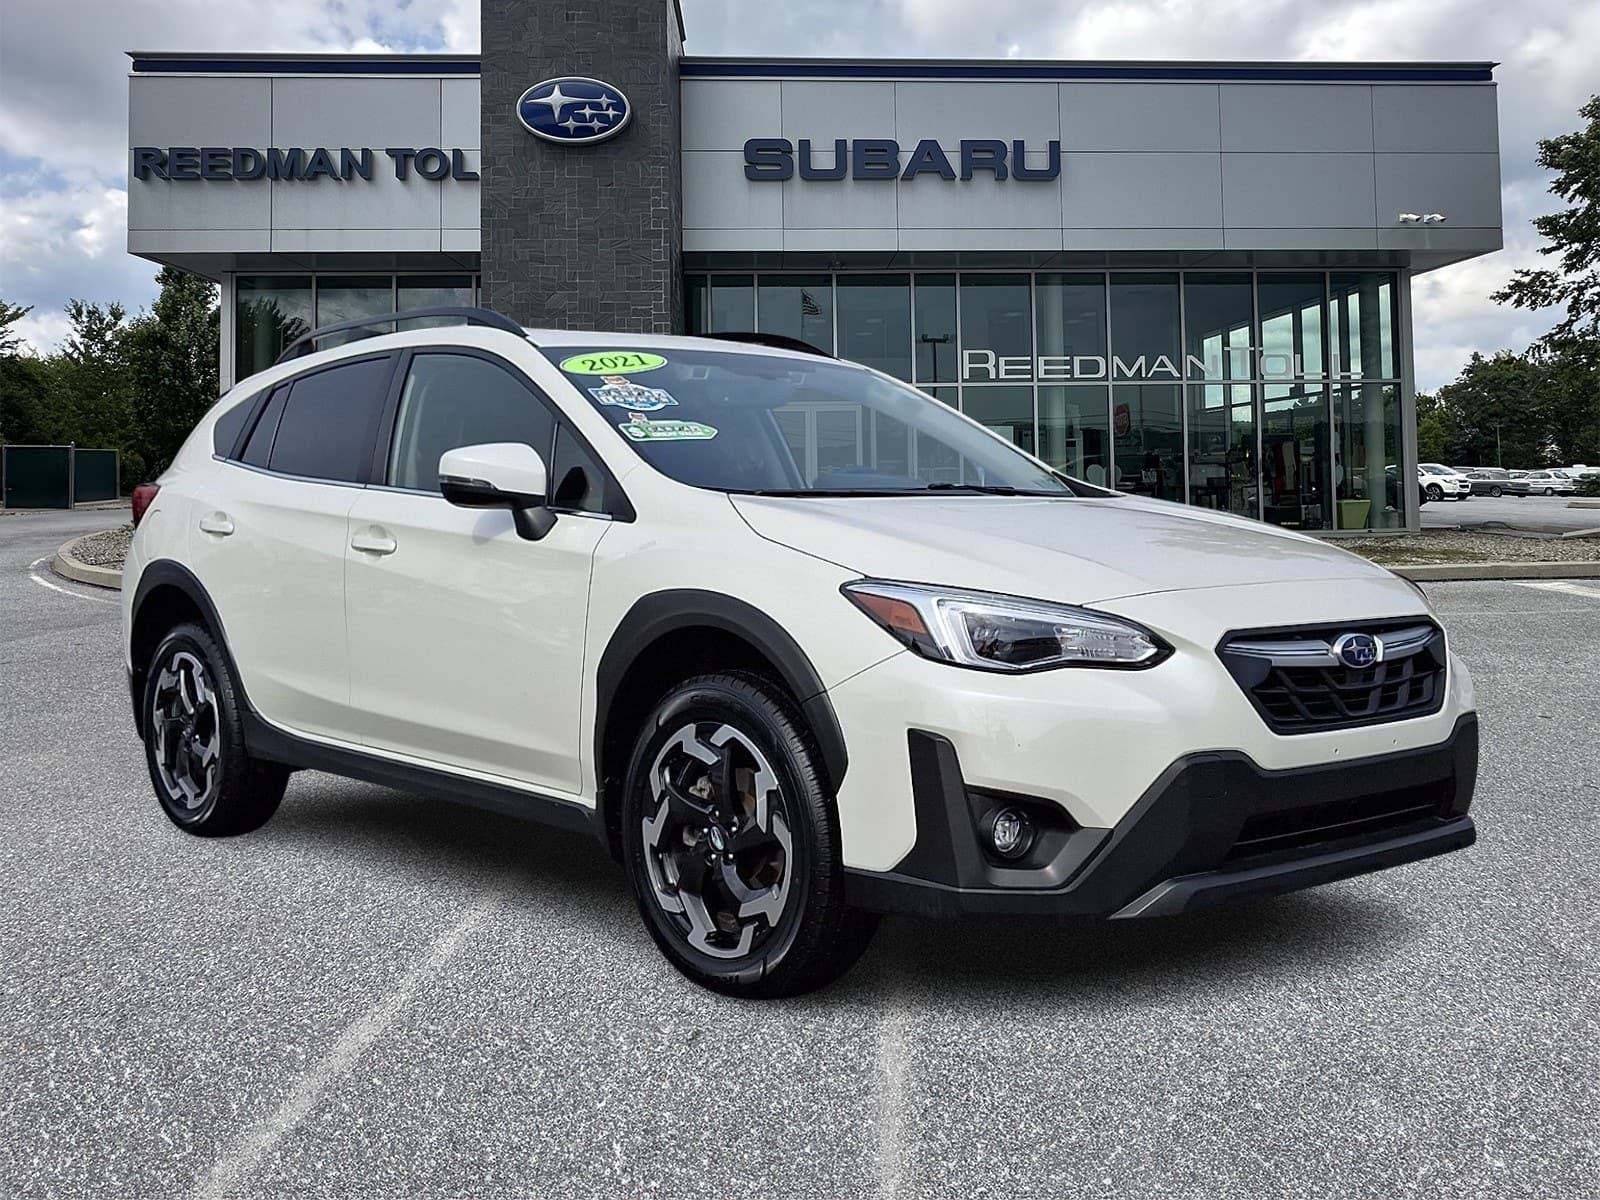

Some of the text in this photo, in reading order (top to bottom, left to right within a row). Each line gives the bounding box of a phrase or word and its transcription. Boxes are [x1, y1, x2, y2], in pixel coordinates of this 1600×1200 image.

[133, 146, 480, 182] REEDMAN TOL
[743, 138, 1063, 181] SUBARU
[581, 354, 649, 371] 2021
